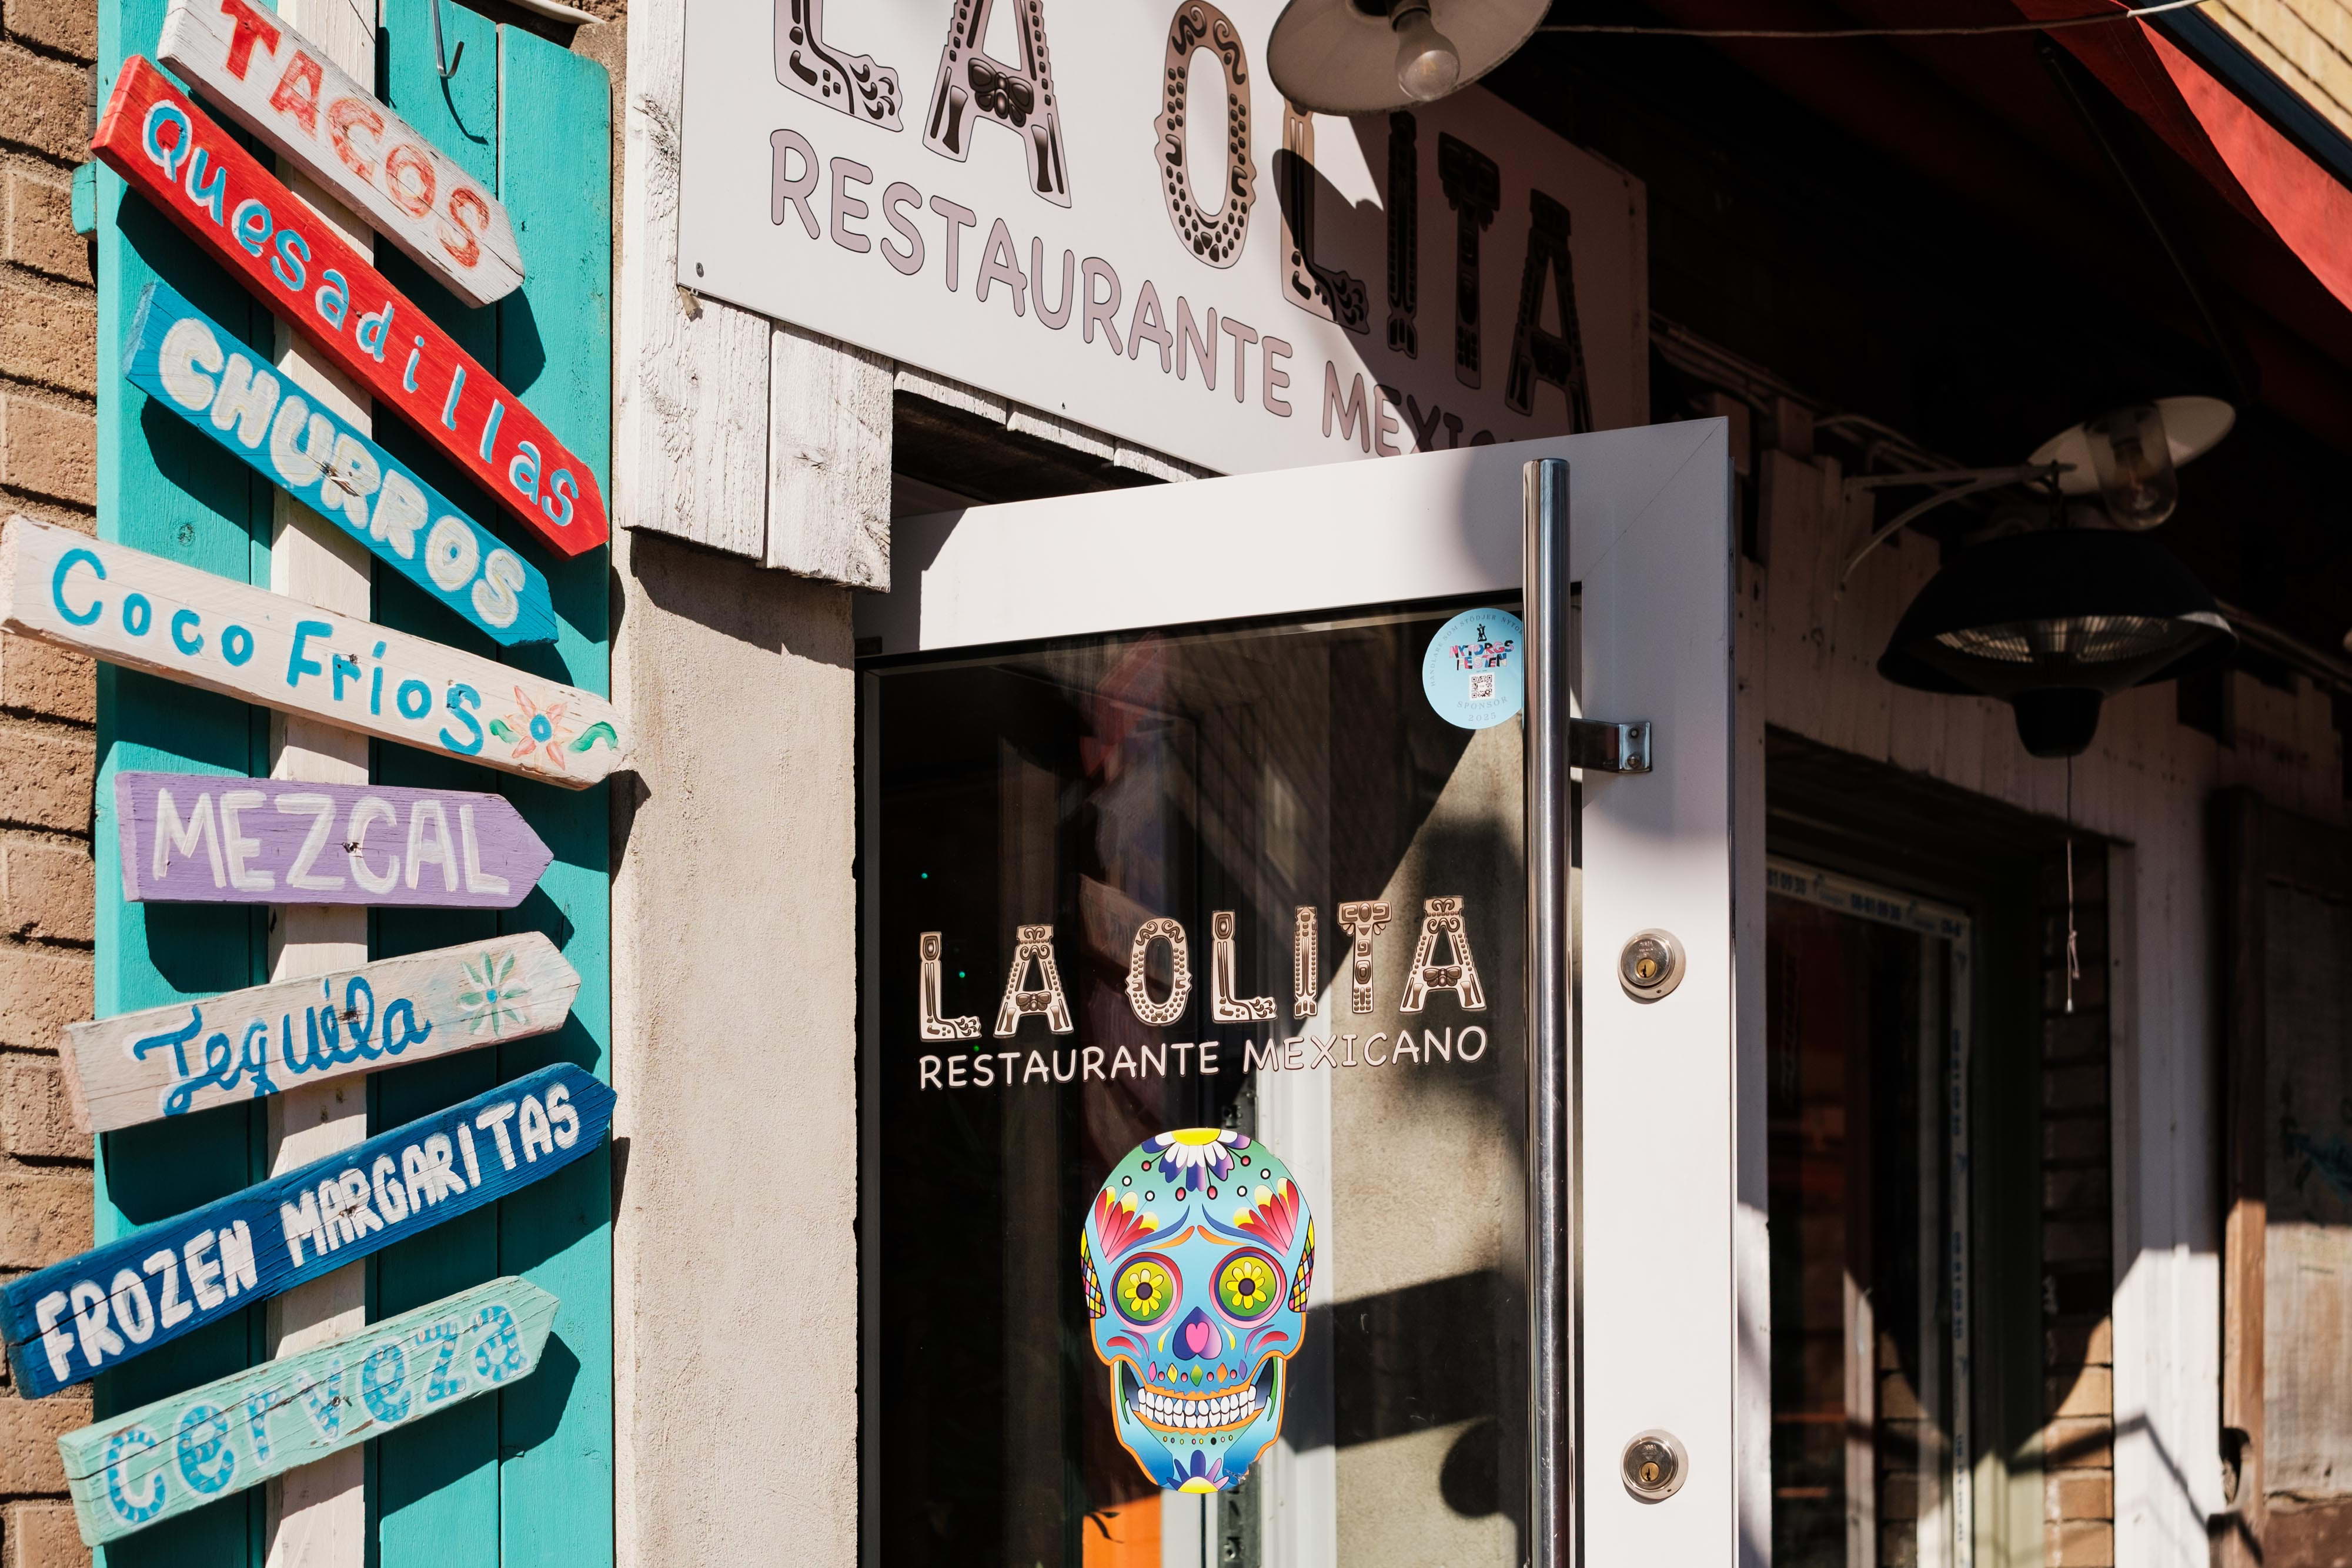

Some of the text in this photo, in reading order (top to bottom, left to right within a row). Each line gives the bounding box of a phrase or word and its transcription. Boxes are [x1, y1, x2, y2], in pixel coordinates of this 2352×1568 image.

[219, 0, 490, 270] TACOS
[770, 128, 1293, 419] RESTAURANTE
[1154, 0, 1595, 435] OLITA
[142, 98, 579, 527] Quesadillas
[159, 317, 526, 629] CHURROS
[52, 547, 254, 667] Coco
[1443, 625, 1458, 640] SOM
[1449, 640, 1515, 658] NYTORGS
[1456, 653, 1507, 670] FESTEN
[1456, 696, 1508, 710] SPONSOR
[1468, 712, 1496, 721] 2025
[152, 787, 510, 895] MEZCAL
[918, 894, 1489, 1044] LA OLITA
[918, 1025, 1489, 1092] RESTAURANTE MEXICANO
[35, 1084, 580, 1382] FROZEN MARGARITAS
